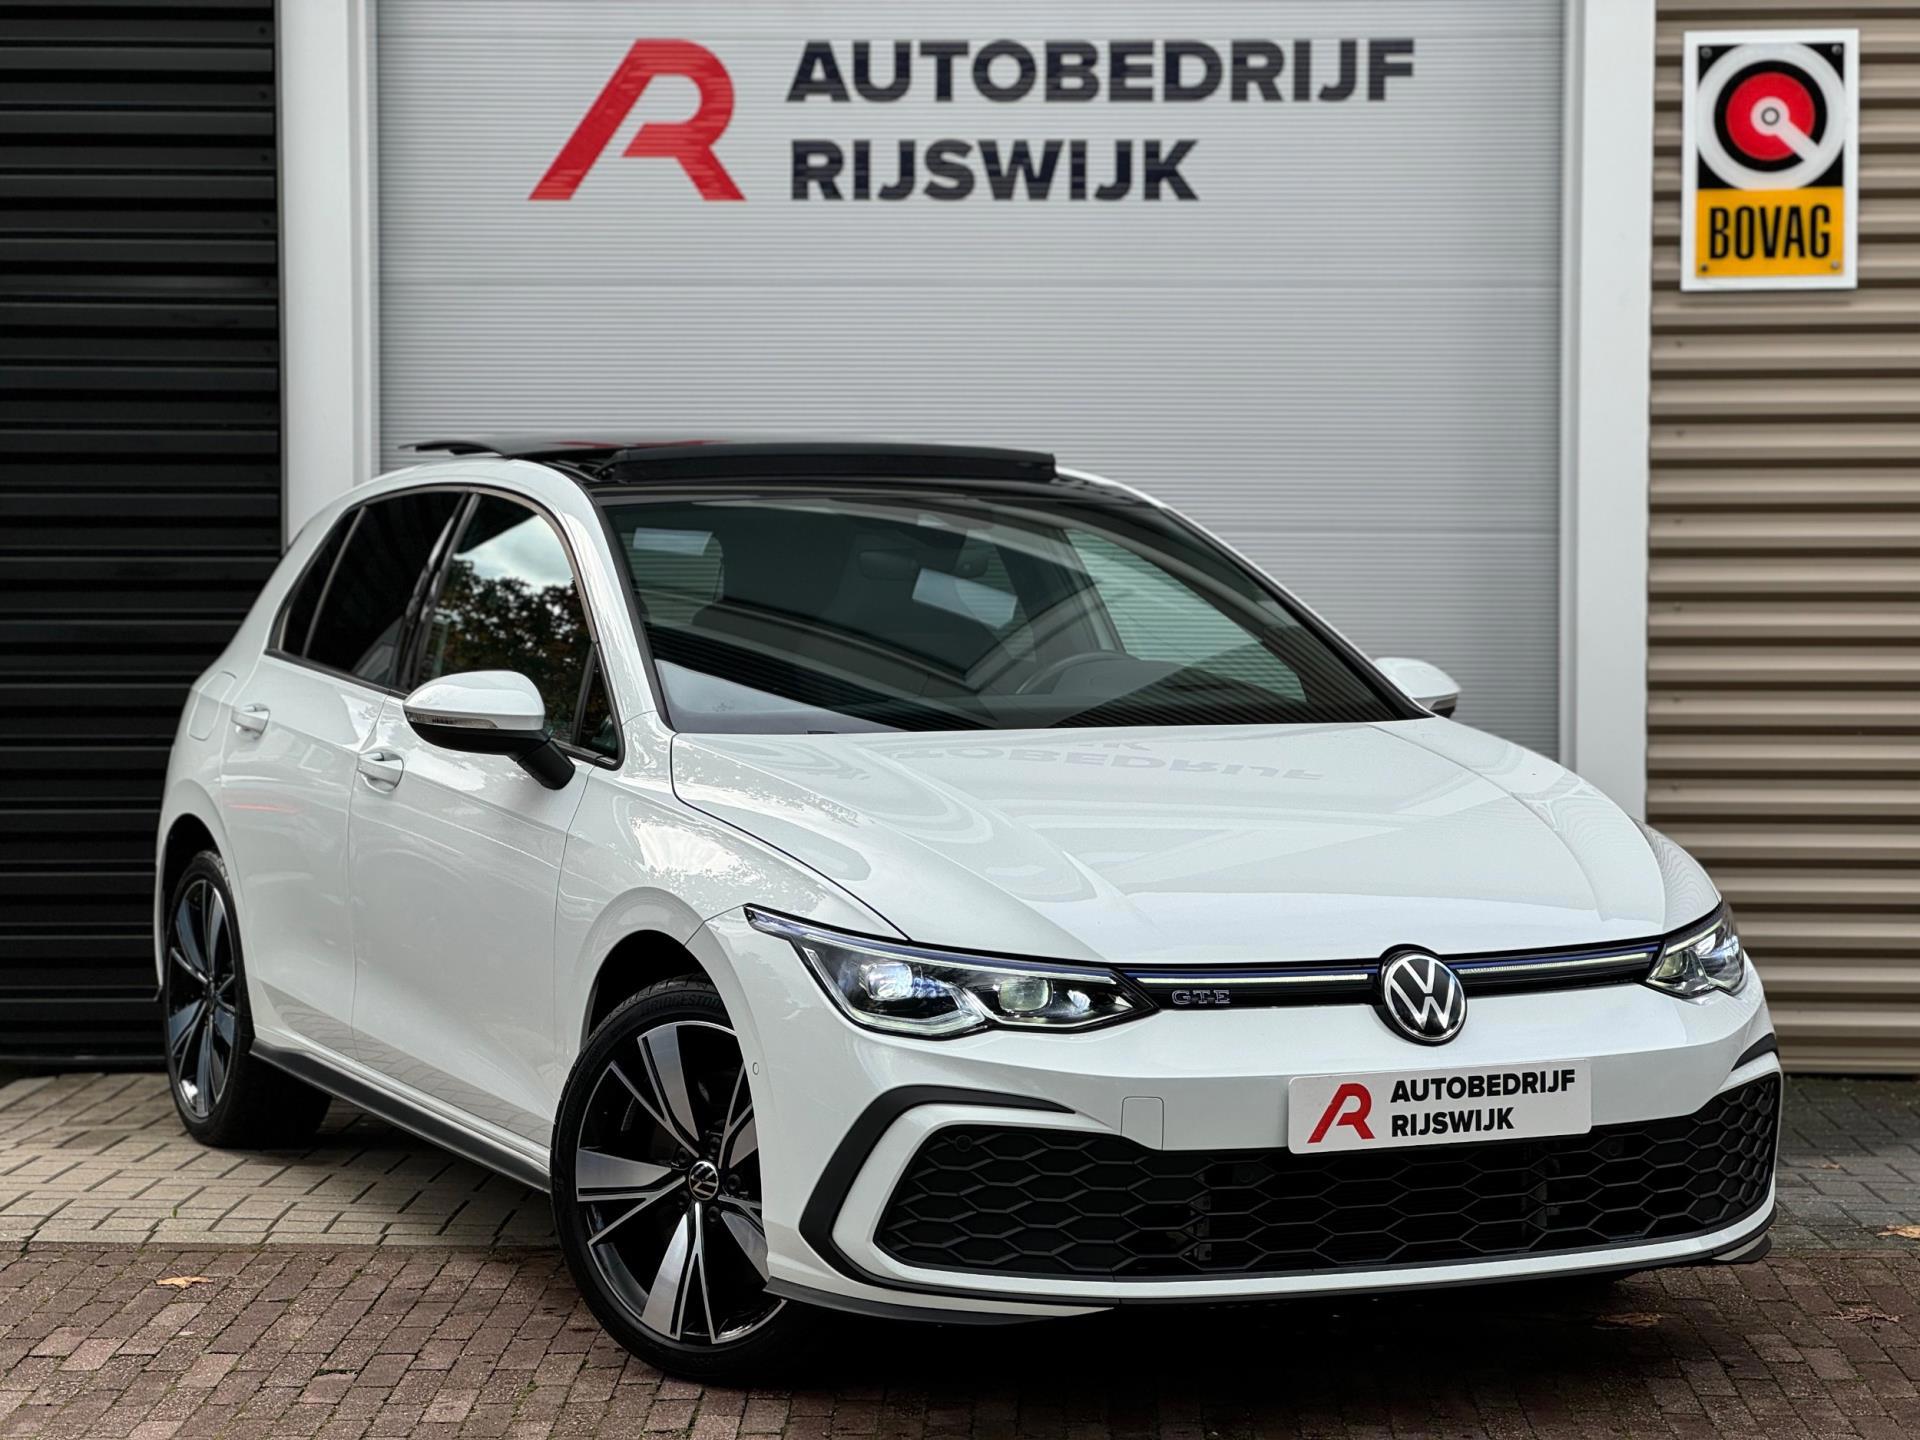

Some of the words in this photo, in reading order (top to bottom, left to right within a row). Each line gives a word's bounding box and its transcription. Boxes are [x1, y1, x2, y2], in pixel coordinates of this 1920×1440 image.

[786, 38, 1414, 102] AUTOBEDRIJF
[791, 139, 1198, 201] RIJSWIJK
[1709, 204, 1831, 260] BOVAG
[1171, 989, 1231, 1005] GTE
[1390, 1069, 1576, 1103] AUTOBEDRIJF
[1391, 1107, 1514, 1138] RIJSWIJK
